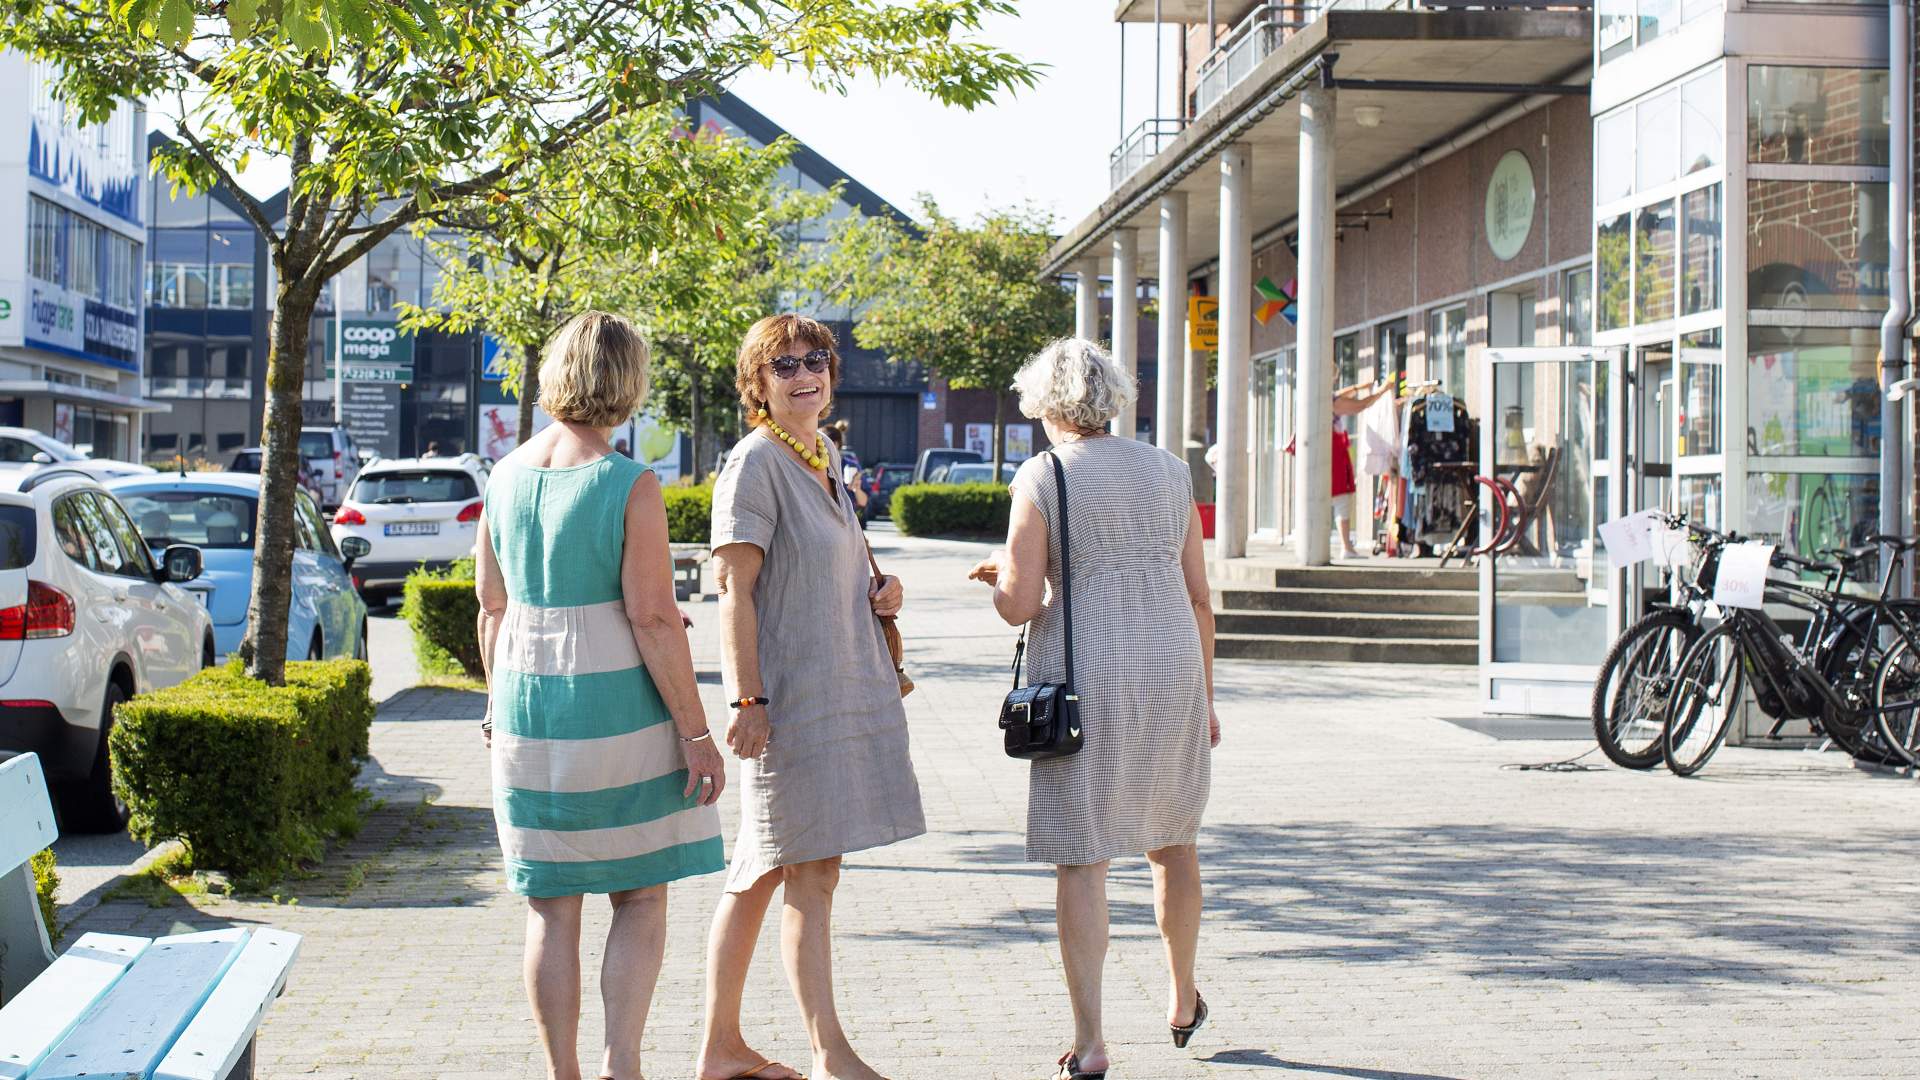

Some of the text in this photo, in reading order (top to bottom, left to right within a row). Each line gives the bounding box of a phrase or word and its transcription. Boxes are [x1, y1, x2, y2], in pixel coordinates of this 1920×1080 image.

[343, 326, 396, 344] coop
[343, 343, 390, 359] mega
[1428, 400, 1453, 412] 70%
